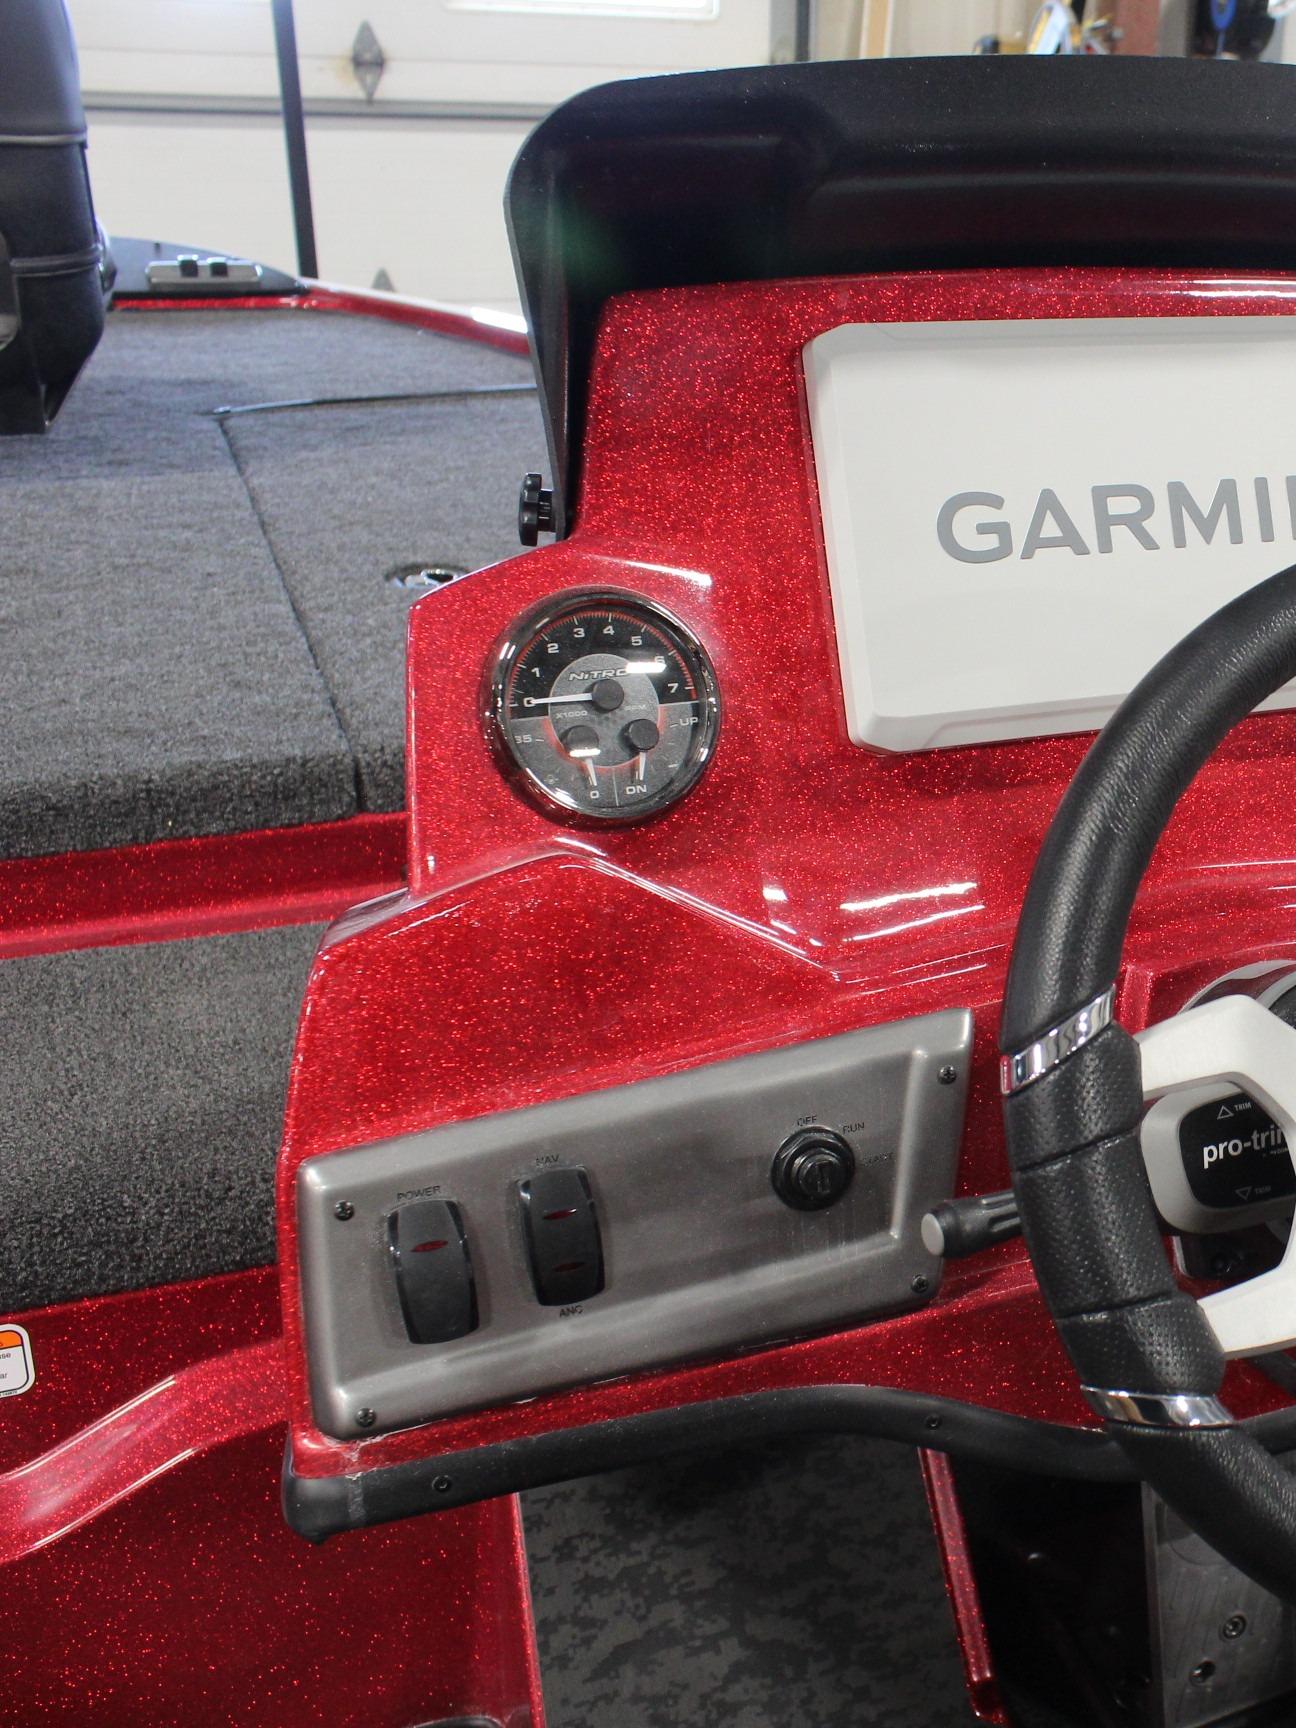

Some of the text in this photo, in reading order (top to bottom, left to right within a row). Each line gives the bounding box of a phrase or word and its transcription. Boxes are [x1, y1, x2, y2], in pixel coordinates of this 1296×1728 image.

[573, 627, 585, 638] 3
[603, 625, 615, 636] 4
[631, 636, 643, 646] 5
[547, 643, 560, 654] 2
[531, 667, 541, 678] 1
[668, 684, 678, 693] 7
[679, 717, 699, 727] UP
[625, 784, 647, 795] DN
[396, 1185, 441, 1201] POWER
